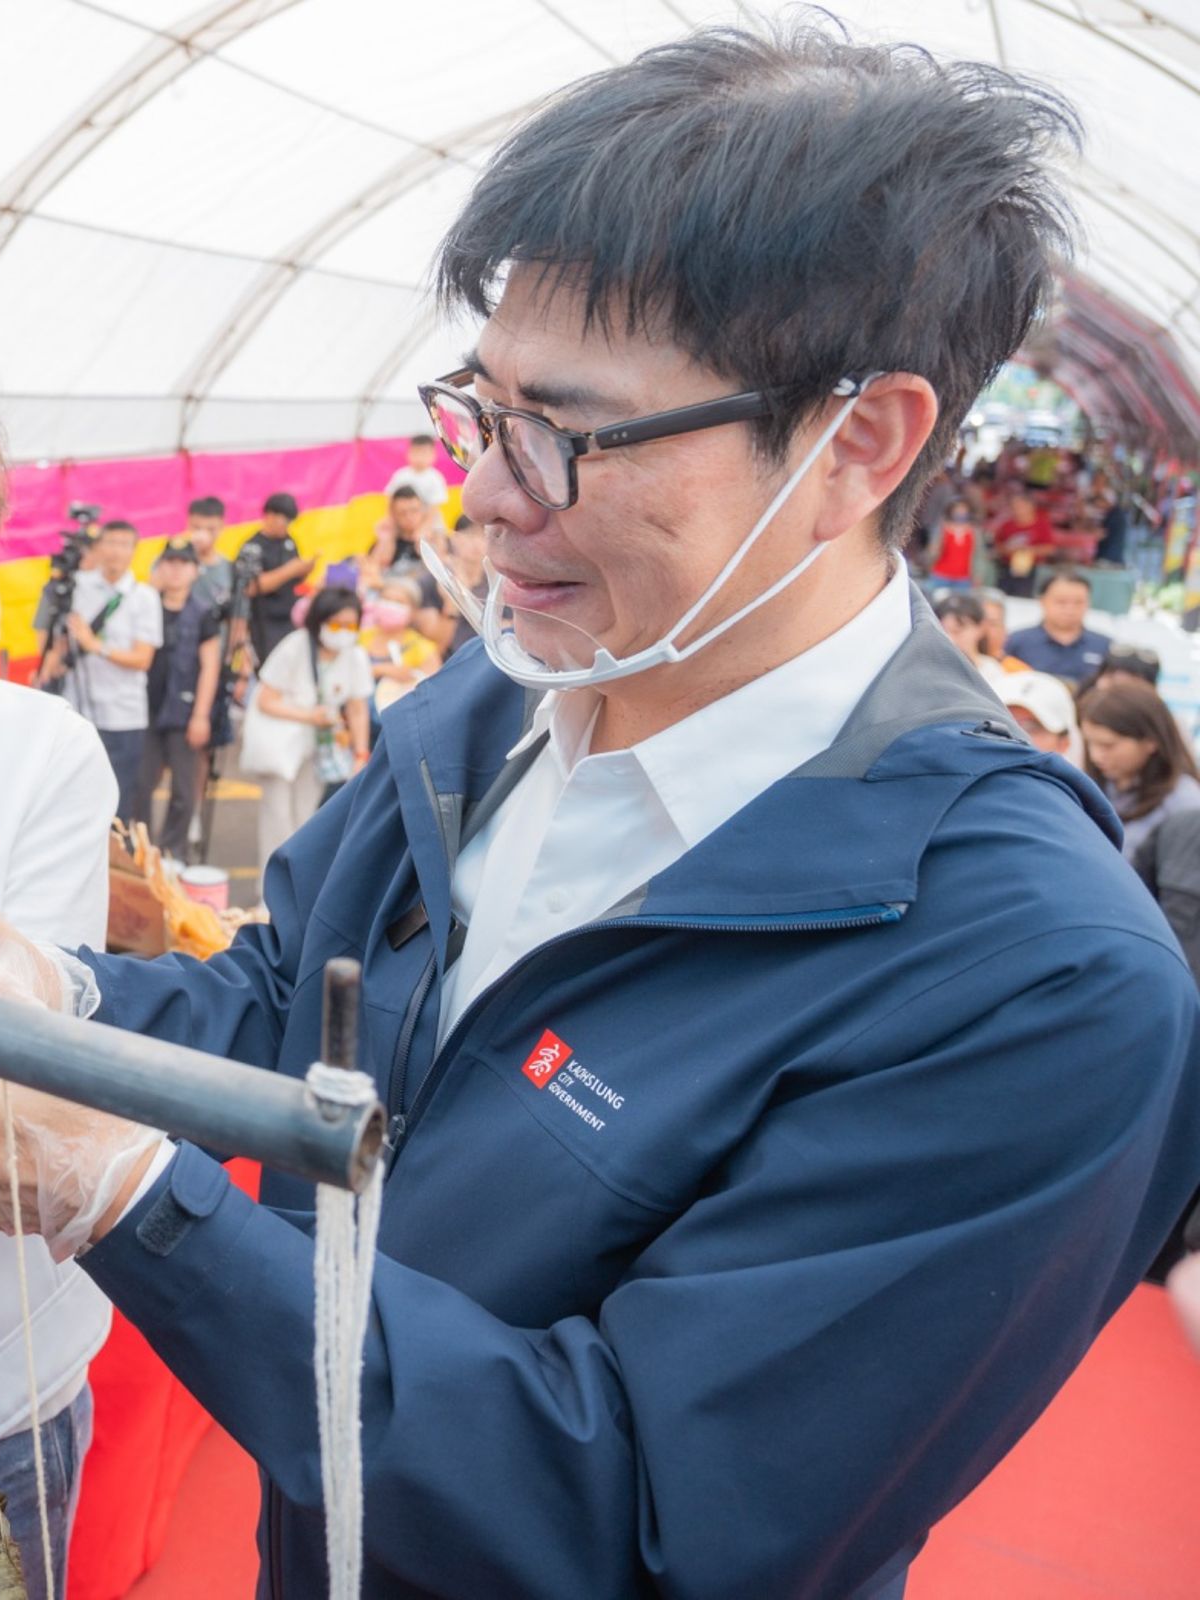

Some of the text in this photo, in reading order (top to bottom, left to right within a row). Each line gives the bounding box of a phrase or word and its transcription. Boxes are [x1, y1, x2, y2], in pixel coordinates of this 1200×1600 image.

[557, 1071, 575, 1088] CITY
[565, 1059, 625, 1110] KAOHSIUNG
[548, 1081, 606, 1132] GOVERNMENT
